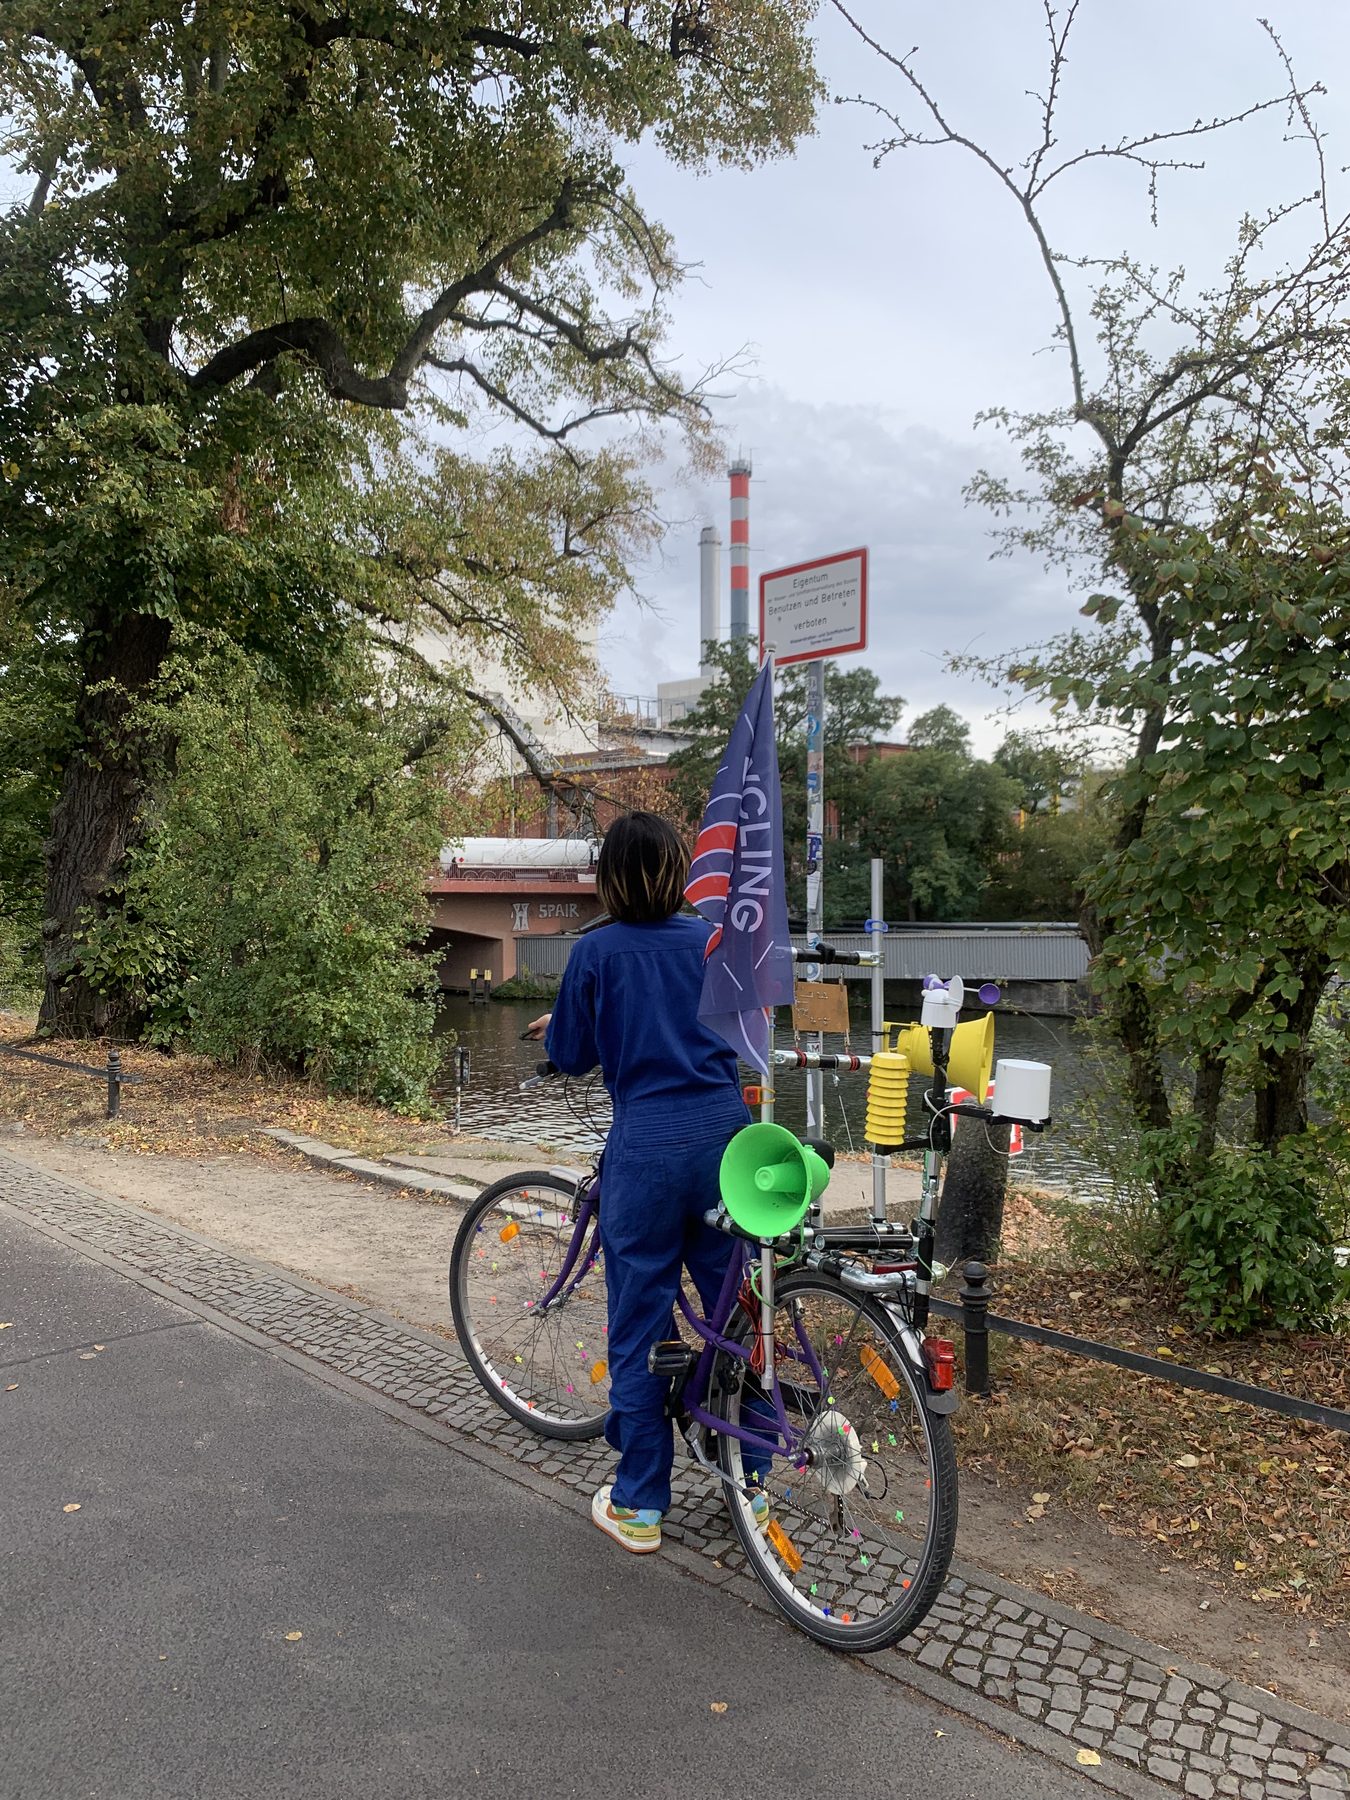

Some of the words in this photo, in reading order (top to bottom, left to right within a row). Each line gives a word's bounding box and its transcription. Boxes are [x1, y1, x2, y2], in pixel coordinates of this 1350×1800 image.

[793, 574, 828, 589] Eigentum
[768, 601, 802, 616] Benutzen
[804, 595, 819, 607] und
[821, 588, 856, 603] Betreten
[793, 617, 827, 631] verboten
